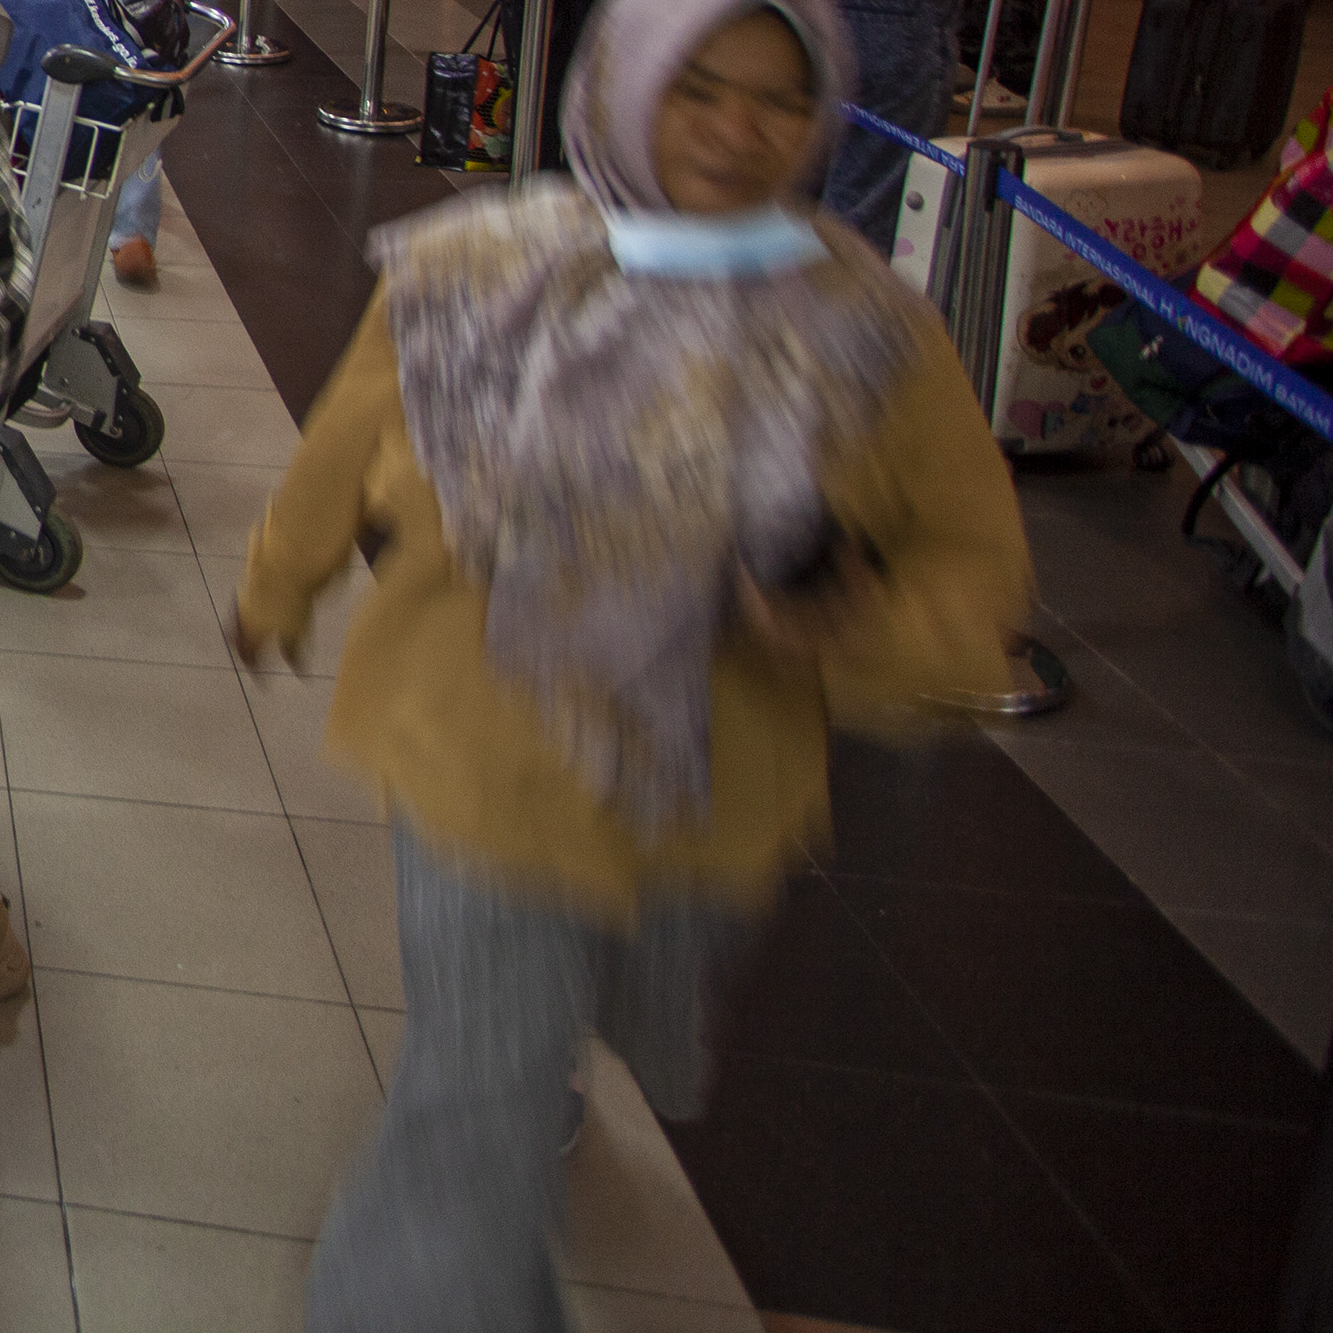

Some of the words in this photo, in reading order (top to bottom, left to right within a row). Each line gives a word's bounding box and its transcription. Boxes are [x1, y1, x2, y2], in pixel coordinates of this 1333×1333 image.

[1014, 194, 1064, 243] BANDARA
[1064, 232, 1157, 310] INTERNASIONAL
[1274, 384, 1332, 433] BATAM
